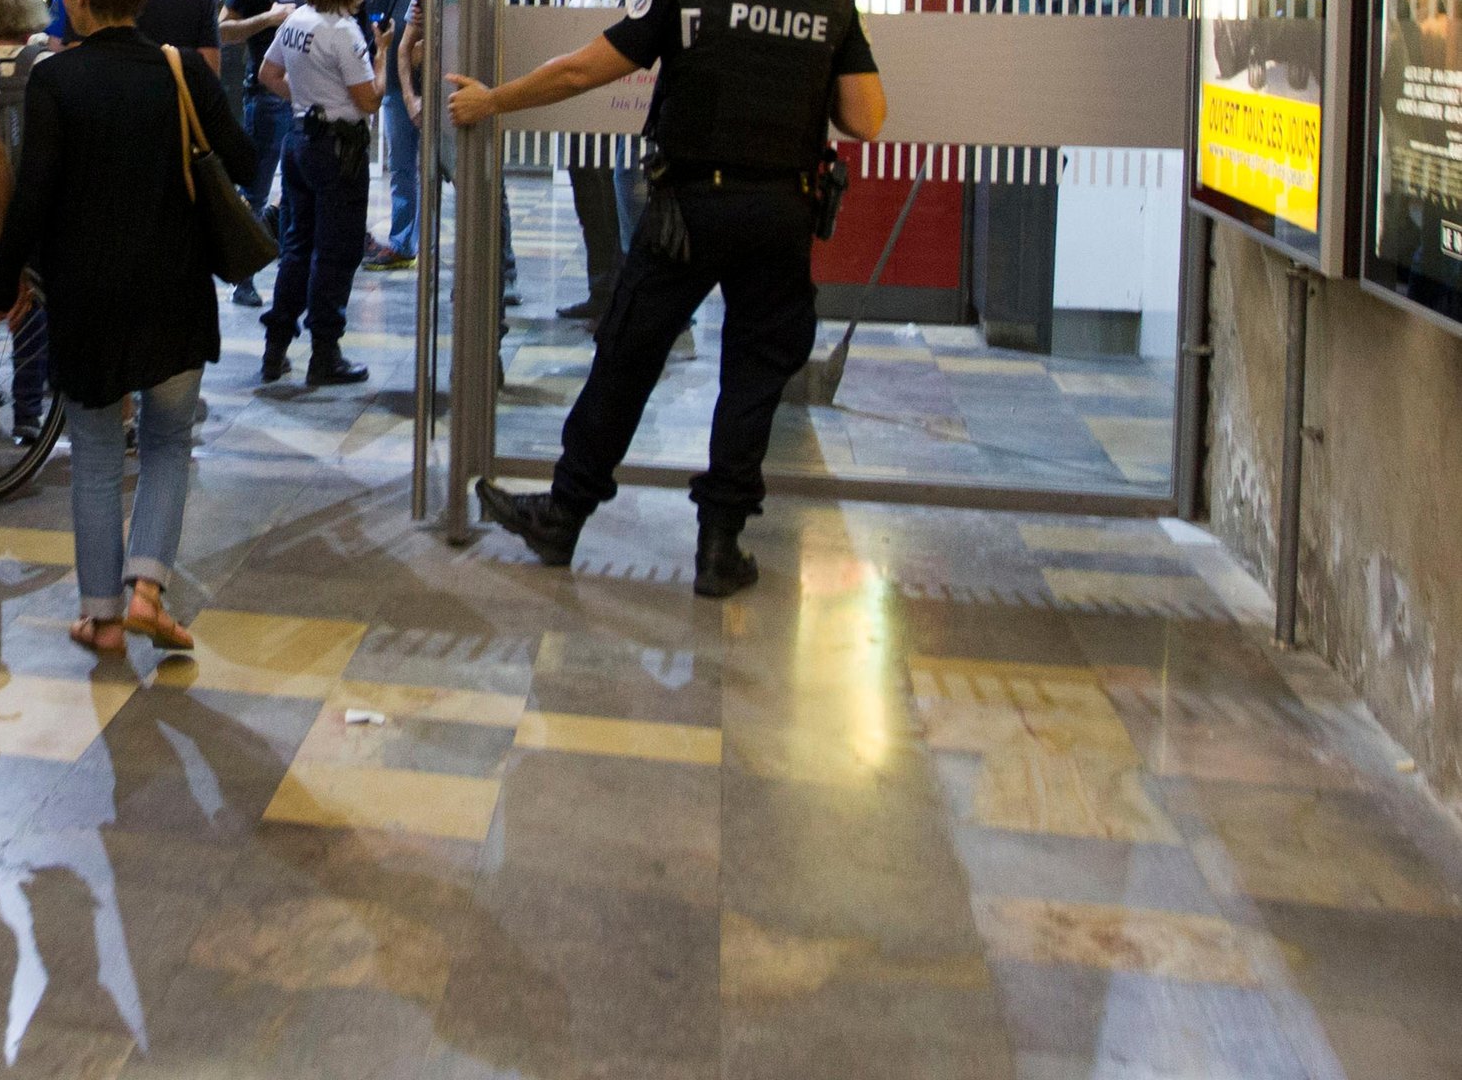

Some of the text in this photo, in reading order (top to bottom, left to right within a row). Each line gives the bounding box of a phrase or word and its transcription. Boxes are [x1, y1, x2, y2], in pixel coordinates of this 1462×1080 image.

[282, 26, 314, 54] OLICE
[729, 2, 828, 43] POLICE
[1209, 97, 1317, 161] OUVERT TOUS LES JOURS
